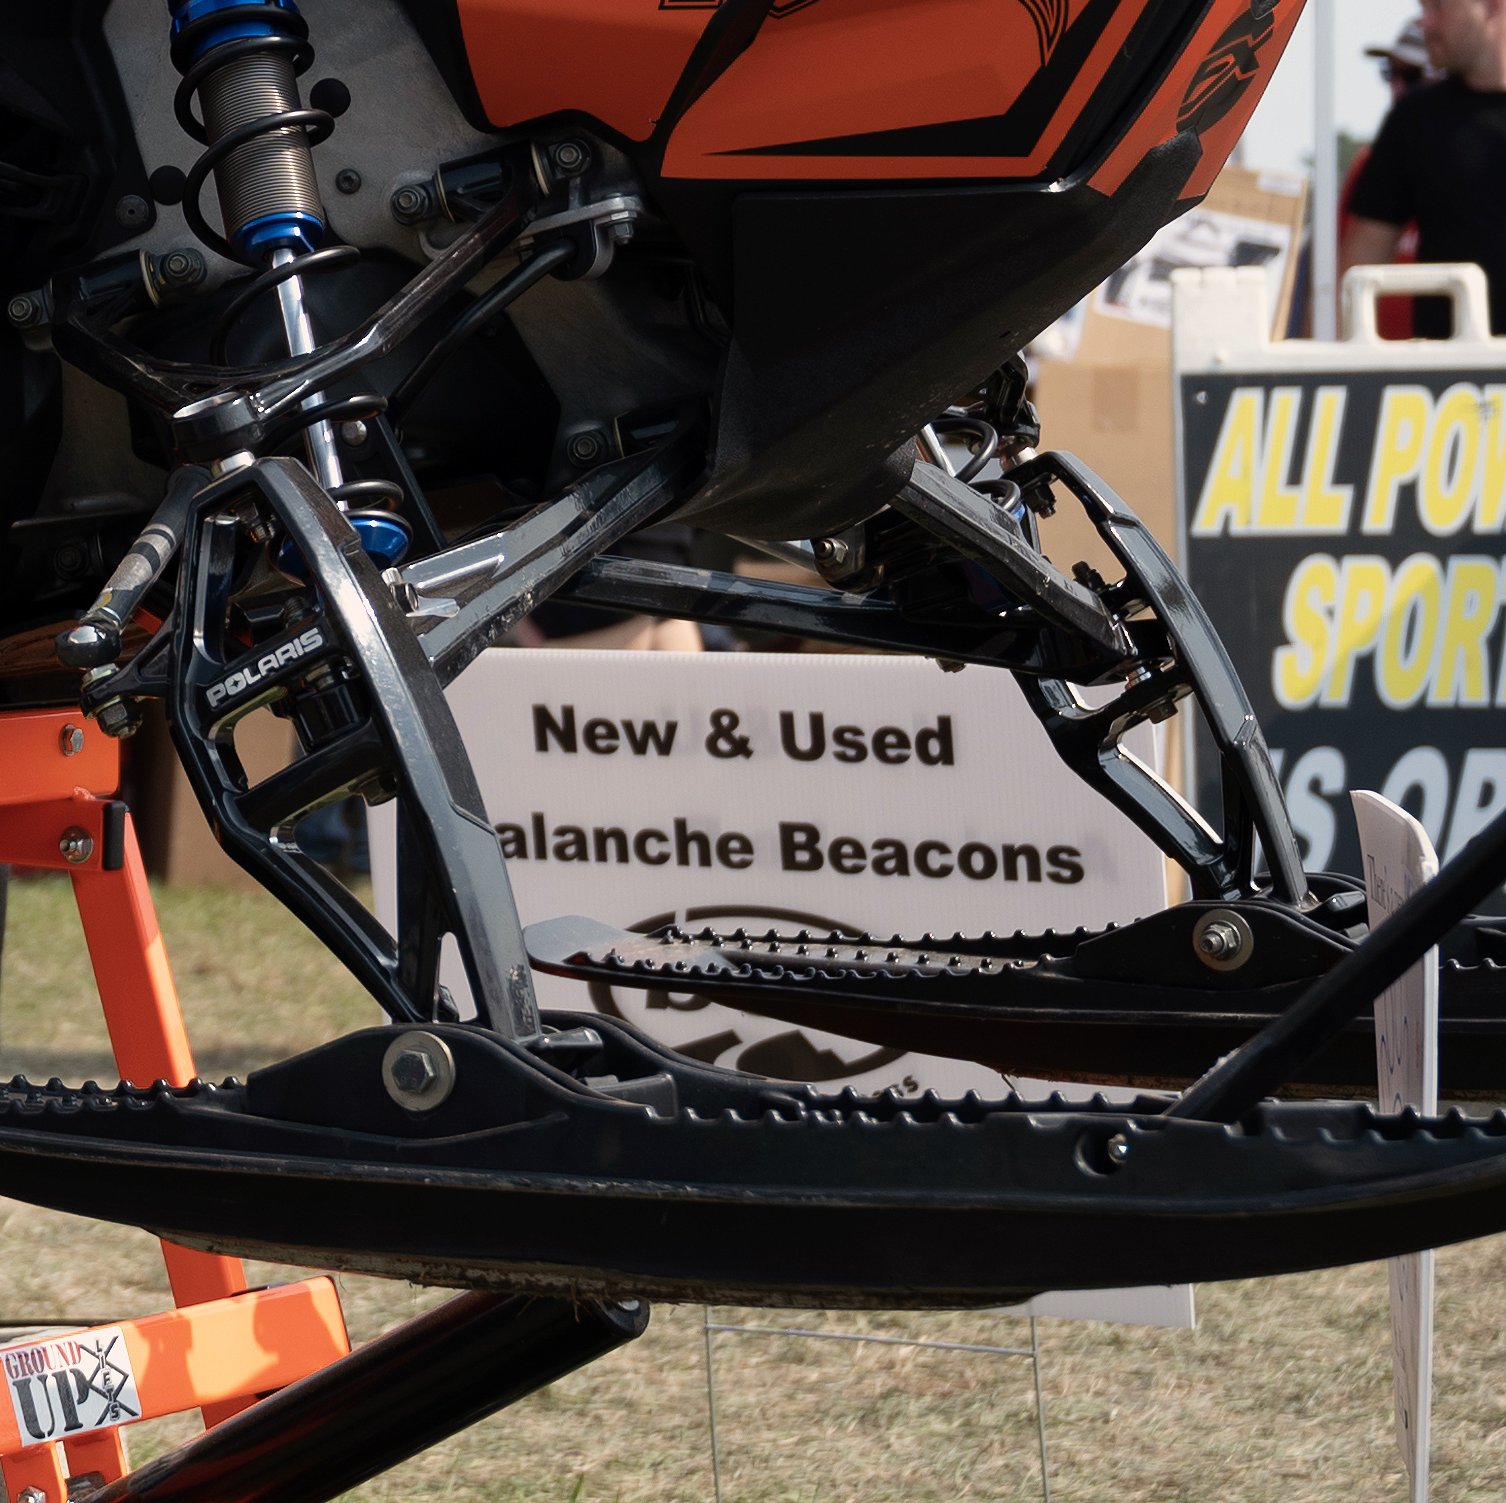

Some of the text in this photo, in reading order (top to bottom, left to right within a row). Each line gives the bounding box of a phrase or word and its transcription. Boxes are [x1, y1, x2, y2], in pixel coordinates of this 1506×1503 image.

[1192, 386, 1354, 537] ALL
[1273, 552, 1506, 710] SPOR
[205, 627, 324, 709] POLARIS
[531, 704, 956, 767] New & Used
[778, 820, 1086, 885] Beacons
[4, 1339, 83, 1380] GROUND
[12, 1368, 92, 1440] UP
